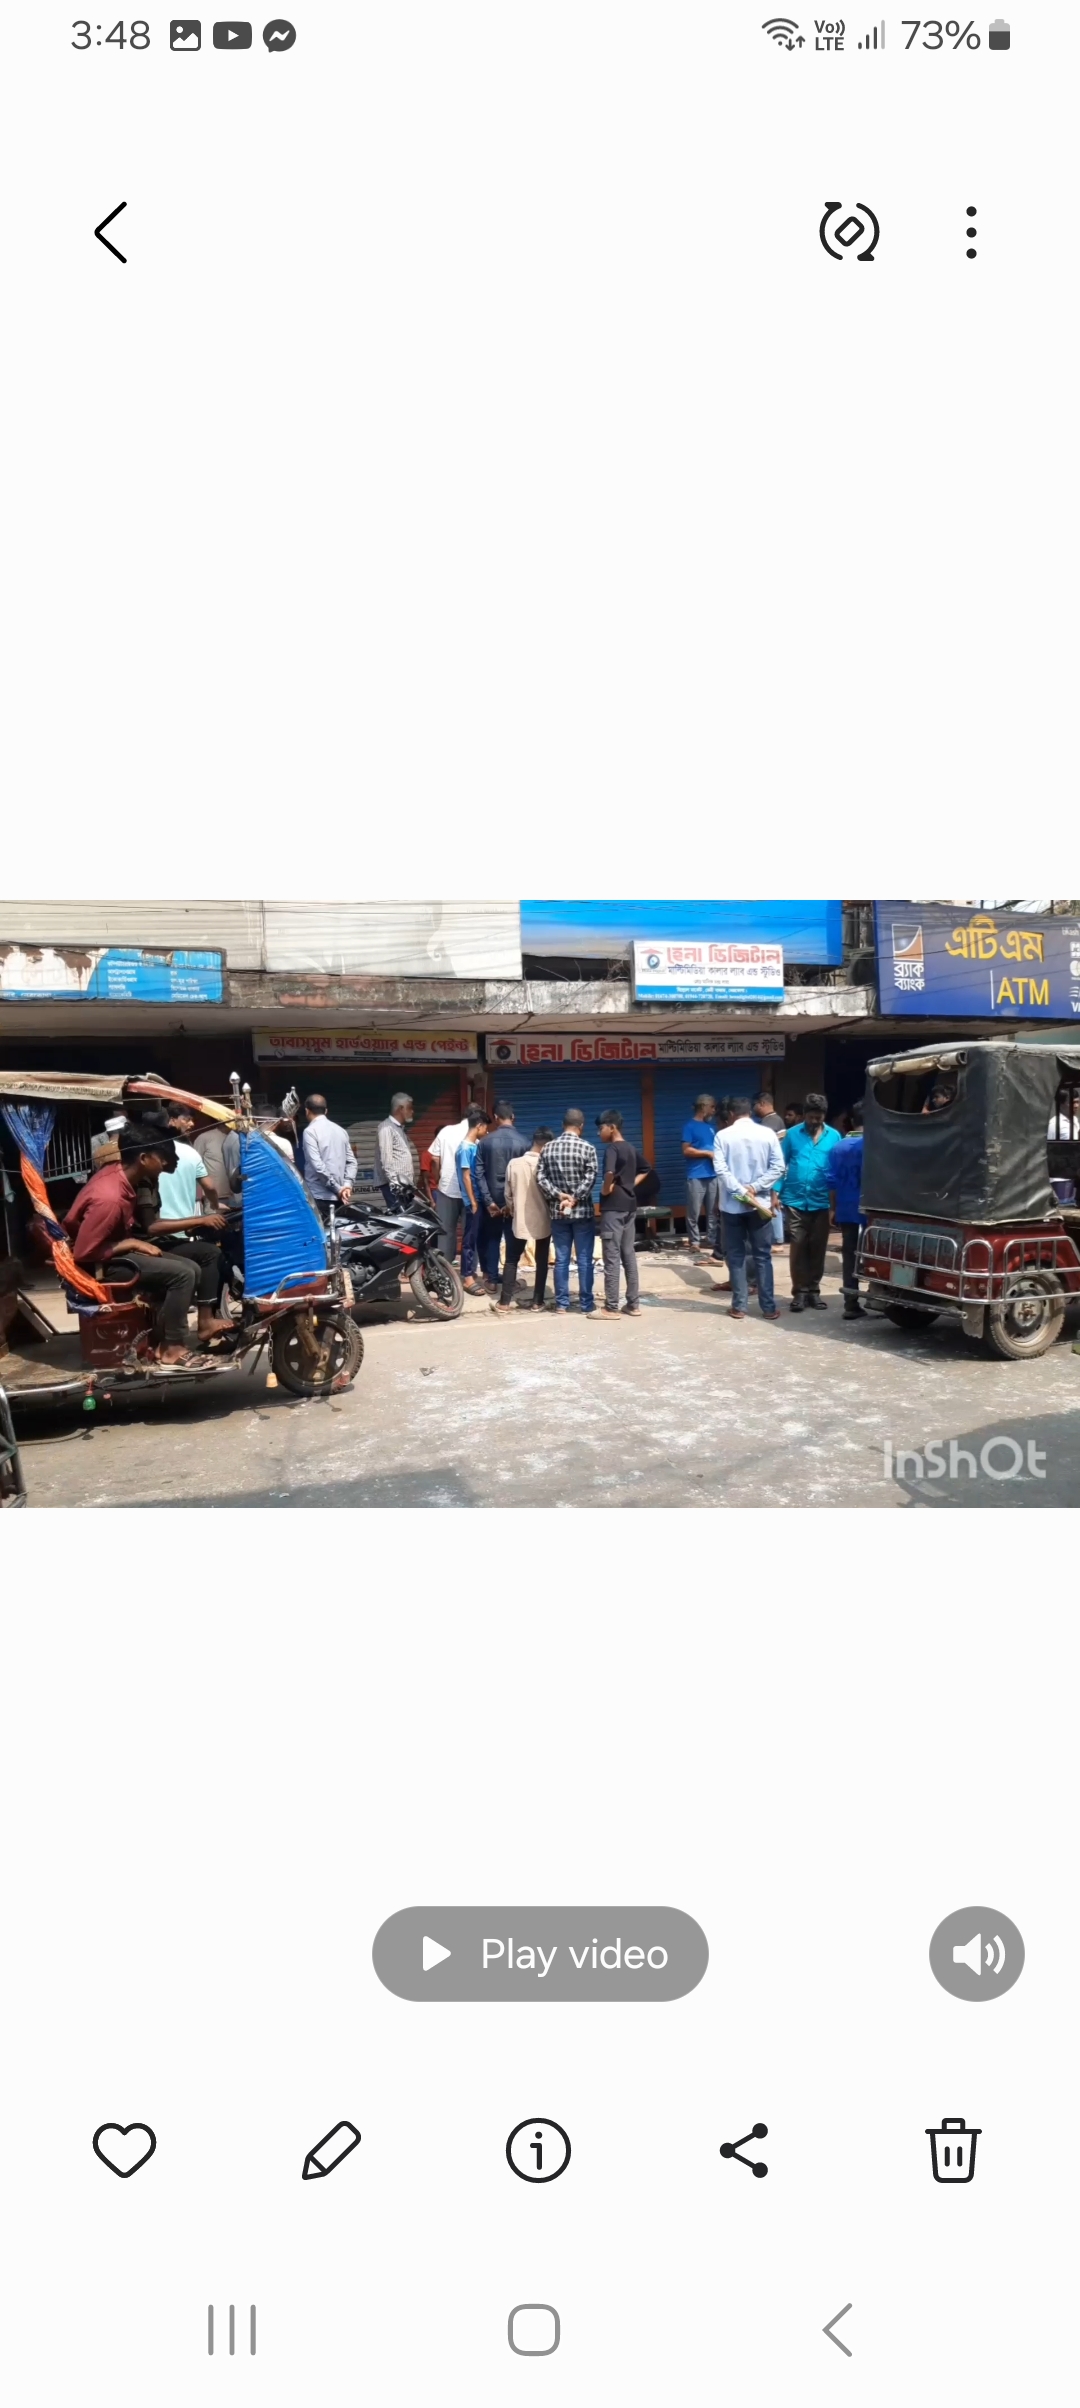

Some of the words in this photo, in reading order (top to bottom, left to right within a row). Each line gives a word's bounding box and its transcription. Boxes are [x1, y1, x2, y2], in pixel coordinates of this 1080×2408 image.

[72, 21, 150, 49] 3:48
[816, 37, 844, 50] LTE
[902, 21, 980, 49] 73%
[667, 947, 702, 964] হেনা
[708, 944, 780, 964] ডিজিটাল
[708, 966, 728, 975] কালার
[730, 967, 744, 976] ল্যাব
[893, 961, 925, 977] ব্র্যাক
[894, 978, 925, 991] ব্যাংক
[997, 977, 1050, 1006] ATM
[403, 1040, 427, 1051] এন্ড
[431, 1038, 469, 1052] পেইন্ট
[520, 1043, 563, 1064] হেনা
[571, 1037, 657, 1061] ডিজিটাল
[659, 1039, 701, 1053] মাল্টিমিডিয়া
[703, 1042, 725, 1053] কালার
[728, 1042, 743, 1053] ল্যাব
[483, 1938, 557, 1977] Play
[569, 1938, 668, 1969] video
